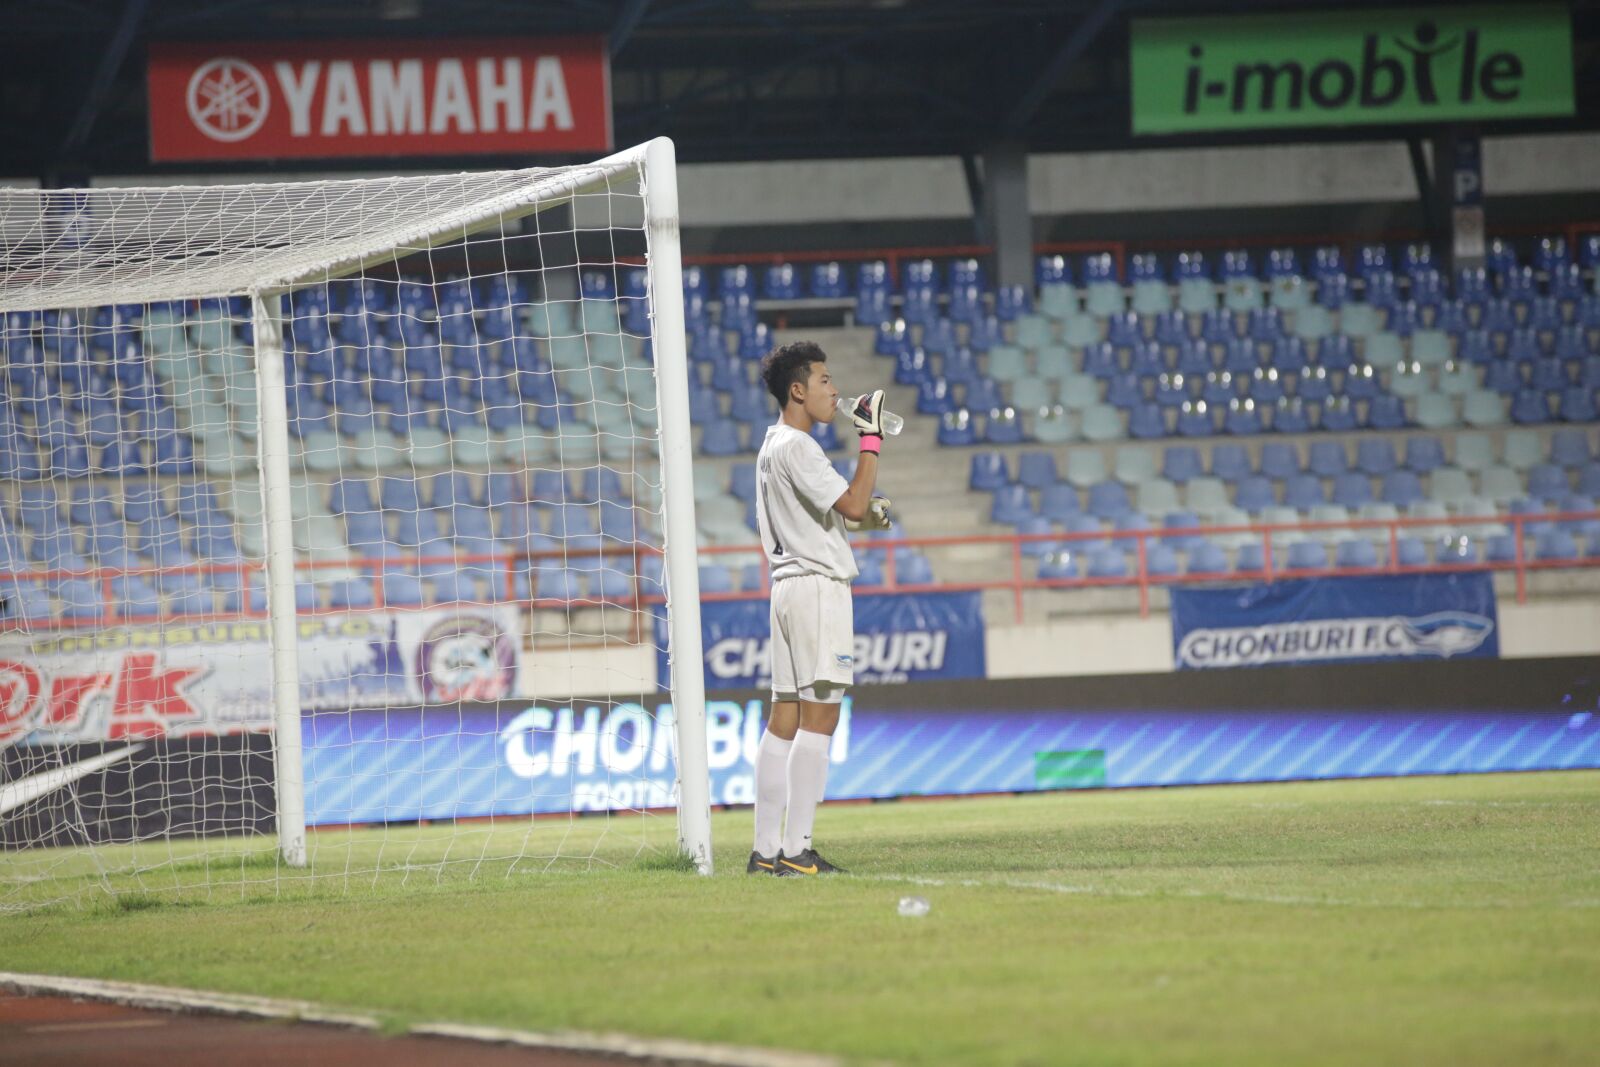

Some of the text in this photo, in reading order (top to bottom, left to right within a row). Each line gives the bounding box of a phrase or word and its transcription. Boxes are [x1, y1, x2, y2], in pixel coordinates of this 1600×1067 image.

[273, 56, 574, 137] YAMAHA
[1184, 20, 1524, 115] i-mobile
[705, 630, 948, 679] CHBURI
[1189, 623, 1354, 661] CHONBURI
[501, 695, 853, 779] CHONBI
